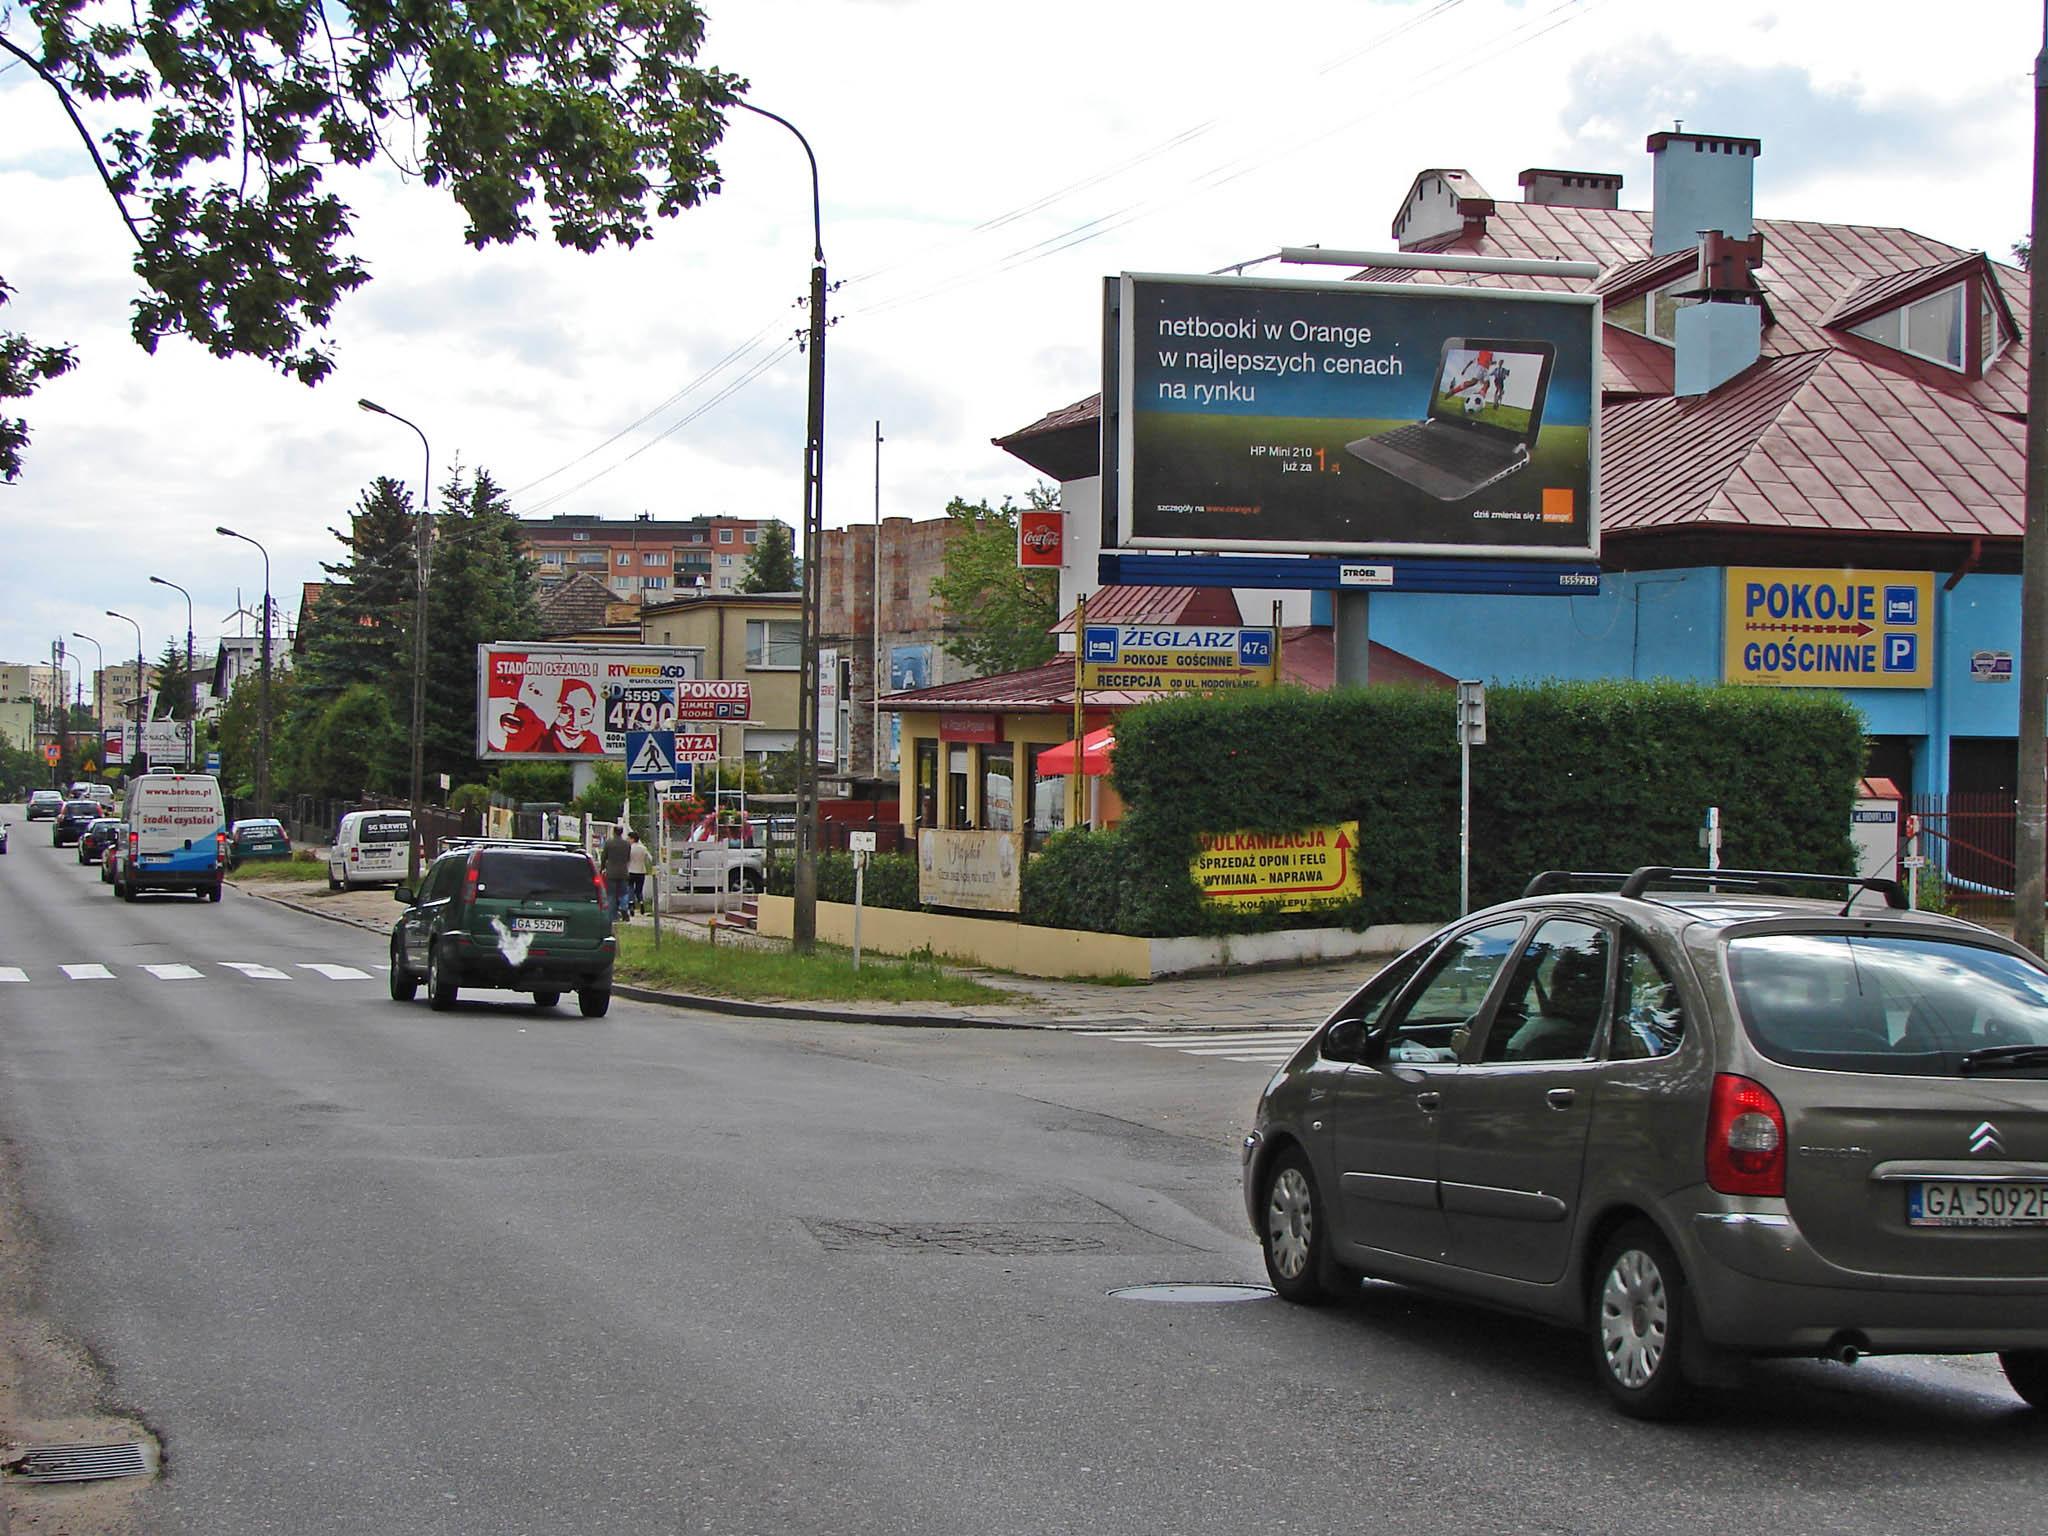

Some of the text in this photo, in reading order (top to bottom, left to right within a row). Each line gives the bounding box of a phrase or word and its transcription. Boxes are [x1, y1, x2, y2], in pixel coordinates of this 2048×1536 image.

[1158, 316, 1372, 348] netbooki w Orange
[1158, 349, 1403, 377] w najlepszych cenach
[1158, 380, 1255, 405] na rynku
[1250, 445, 1312, 458] HP Mini 210
[1282, 460, 1312, 473] już za
[1315, 447, 1326, 472] 1
[1194, 504, 1205, 513] na
[1473, 510, 1490, 519] dziś
[1491, 511, 1522, 520] zmienia
[1745, 582, 1876, 621] POKOJE
[1121, 627, 1236, 648] ŻEGLARZ
[1242, 641, 1269, 656] 47a
[1743, 637, 1877, 673] GOŚCINNE
[1891, 639, 1911, 666] P
[1123, 653, 1234, 667] POKOJE GOŚCINNE
[495, 660, 543, 676] STADION
[1096, 675, 1162, 688] RECEPCJA
[1169, 679, 1181, 688] OD
[1184, 679, 1199, 689] UL.
[623, 690, 660, 702] 5599
[679, 682, 749, 699] POKOJE
[681, 702, 715, 710] ZIMMER
[681, 709, 713, 718] ROOMS
[718, 705, 729, 717] P
[608, 701, 675, 731] 4790
[675, 736, 714, 750] RYZA
[677, 752, 717, 761] CEPCJA
[378, 822, 408, 830] SERWIS
[1199, 853, 1257, 870] SPRZEDAŻ
[1259, 854, 1290, 867] OPON
[1299, 853, 1327, 865] FELG
[1203, 872, 1257, 886] WYMIANA
[1268, 870, 1323, 884] NAPRAWA
[516, 918, 564, 930] GA 5529M
[1927, 1187, 1965, 1215] GA
